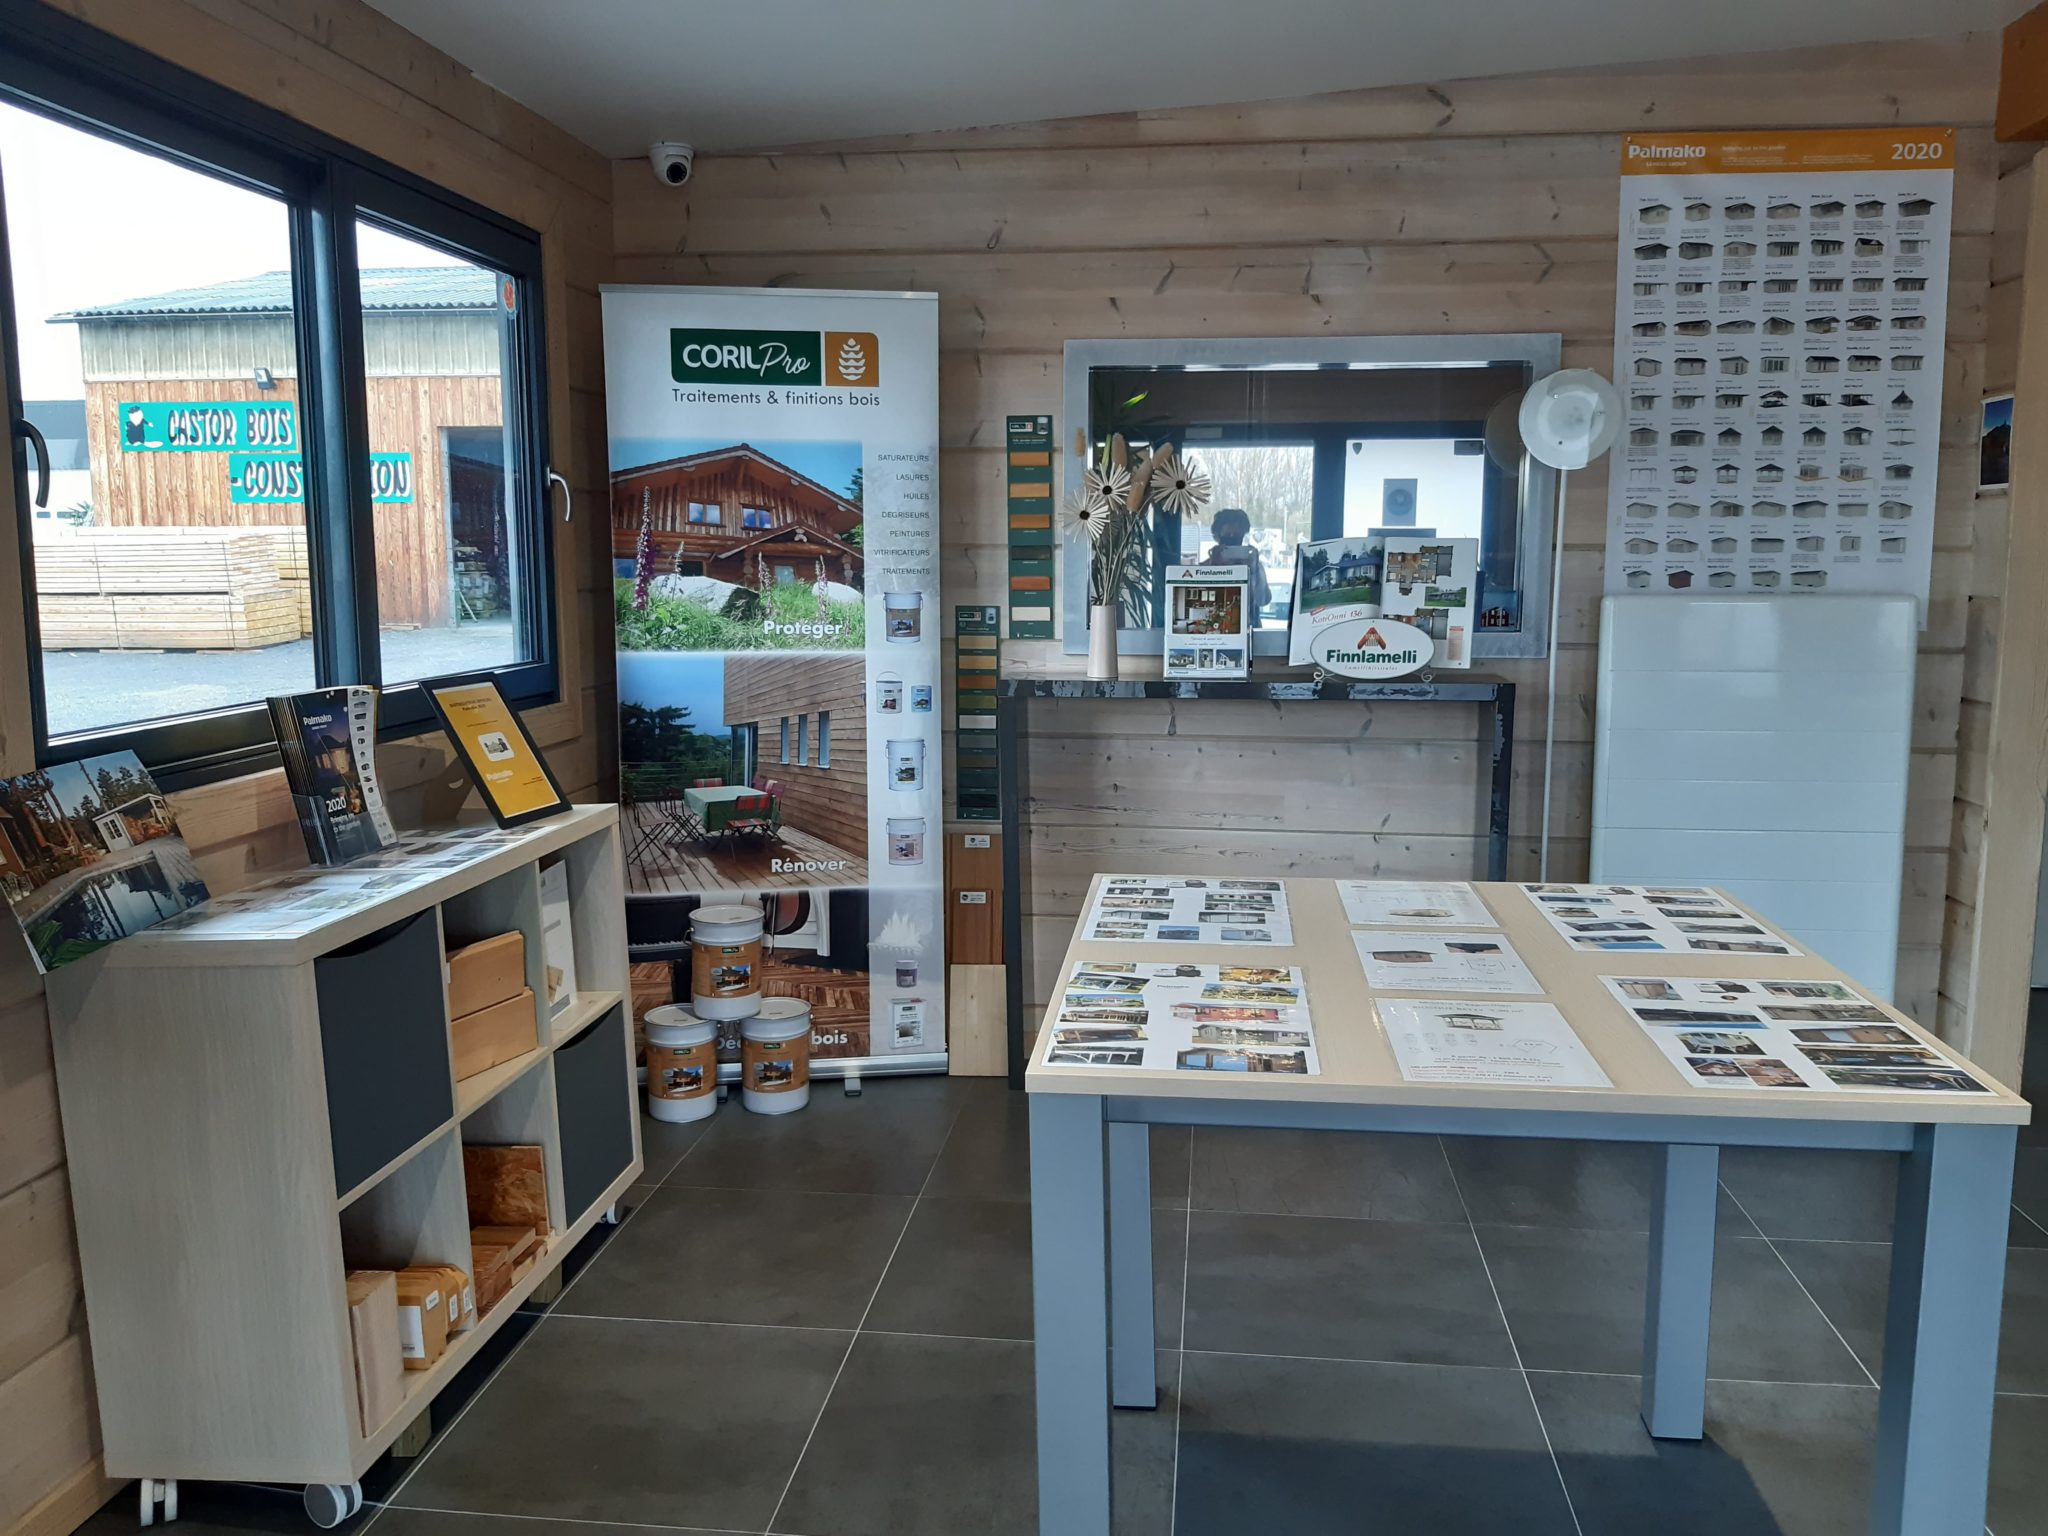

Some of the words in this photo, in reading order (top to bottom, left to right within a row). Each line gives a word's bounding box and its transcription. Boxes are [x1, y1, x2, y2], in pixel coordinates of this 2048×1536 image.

[1628, 144, 1706, 158] Palmako
[1891, 142, 1943, 160] 2020
[672, 388, 761, 404] Traitements
[767, 390, 779, 404] &
[785, 390, 844, 405] finitions
[849, 392, 880, 406] bois
[168, 408, 236, 446] CASTOR
[246, 408, 294, 446] BOIS
[877, 454, 929, 462] SATURATEURS
[896, 473, 930, 481] LASURES
[903, 492, 930, 500] HUILES
[882, 567, 931, 575] TRAITEMENTS
[763, 619, 843, 639] Protéger
[1326, 649, 1417, 664] Finnlamelli
[303, 714, 332, 726] Palmako
[326, 797, 347, 813] 2020
[771, 857, 847, 873] Rénover
[811, 1029, 848, 1045] bois
